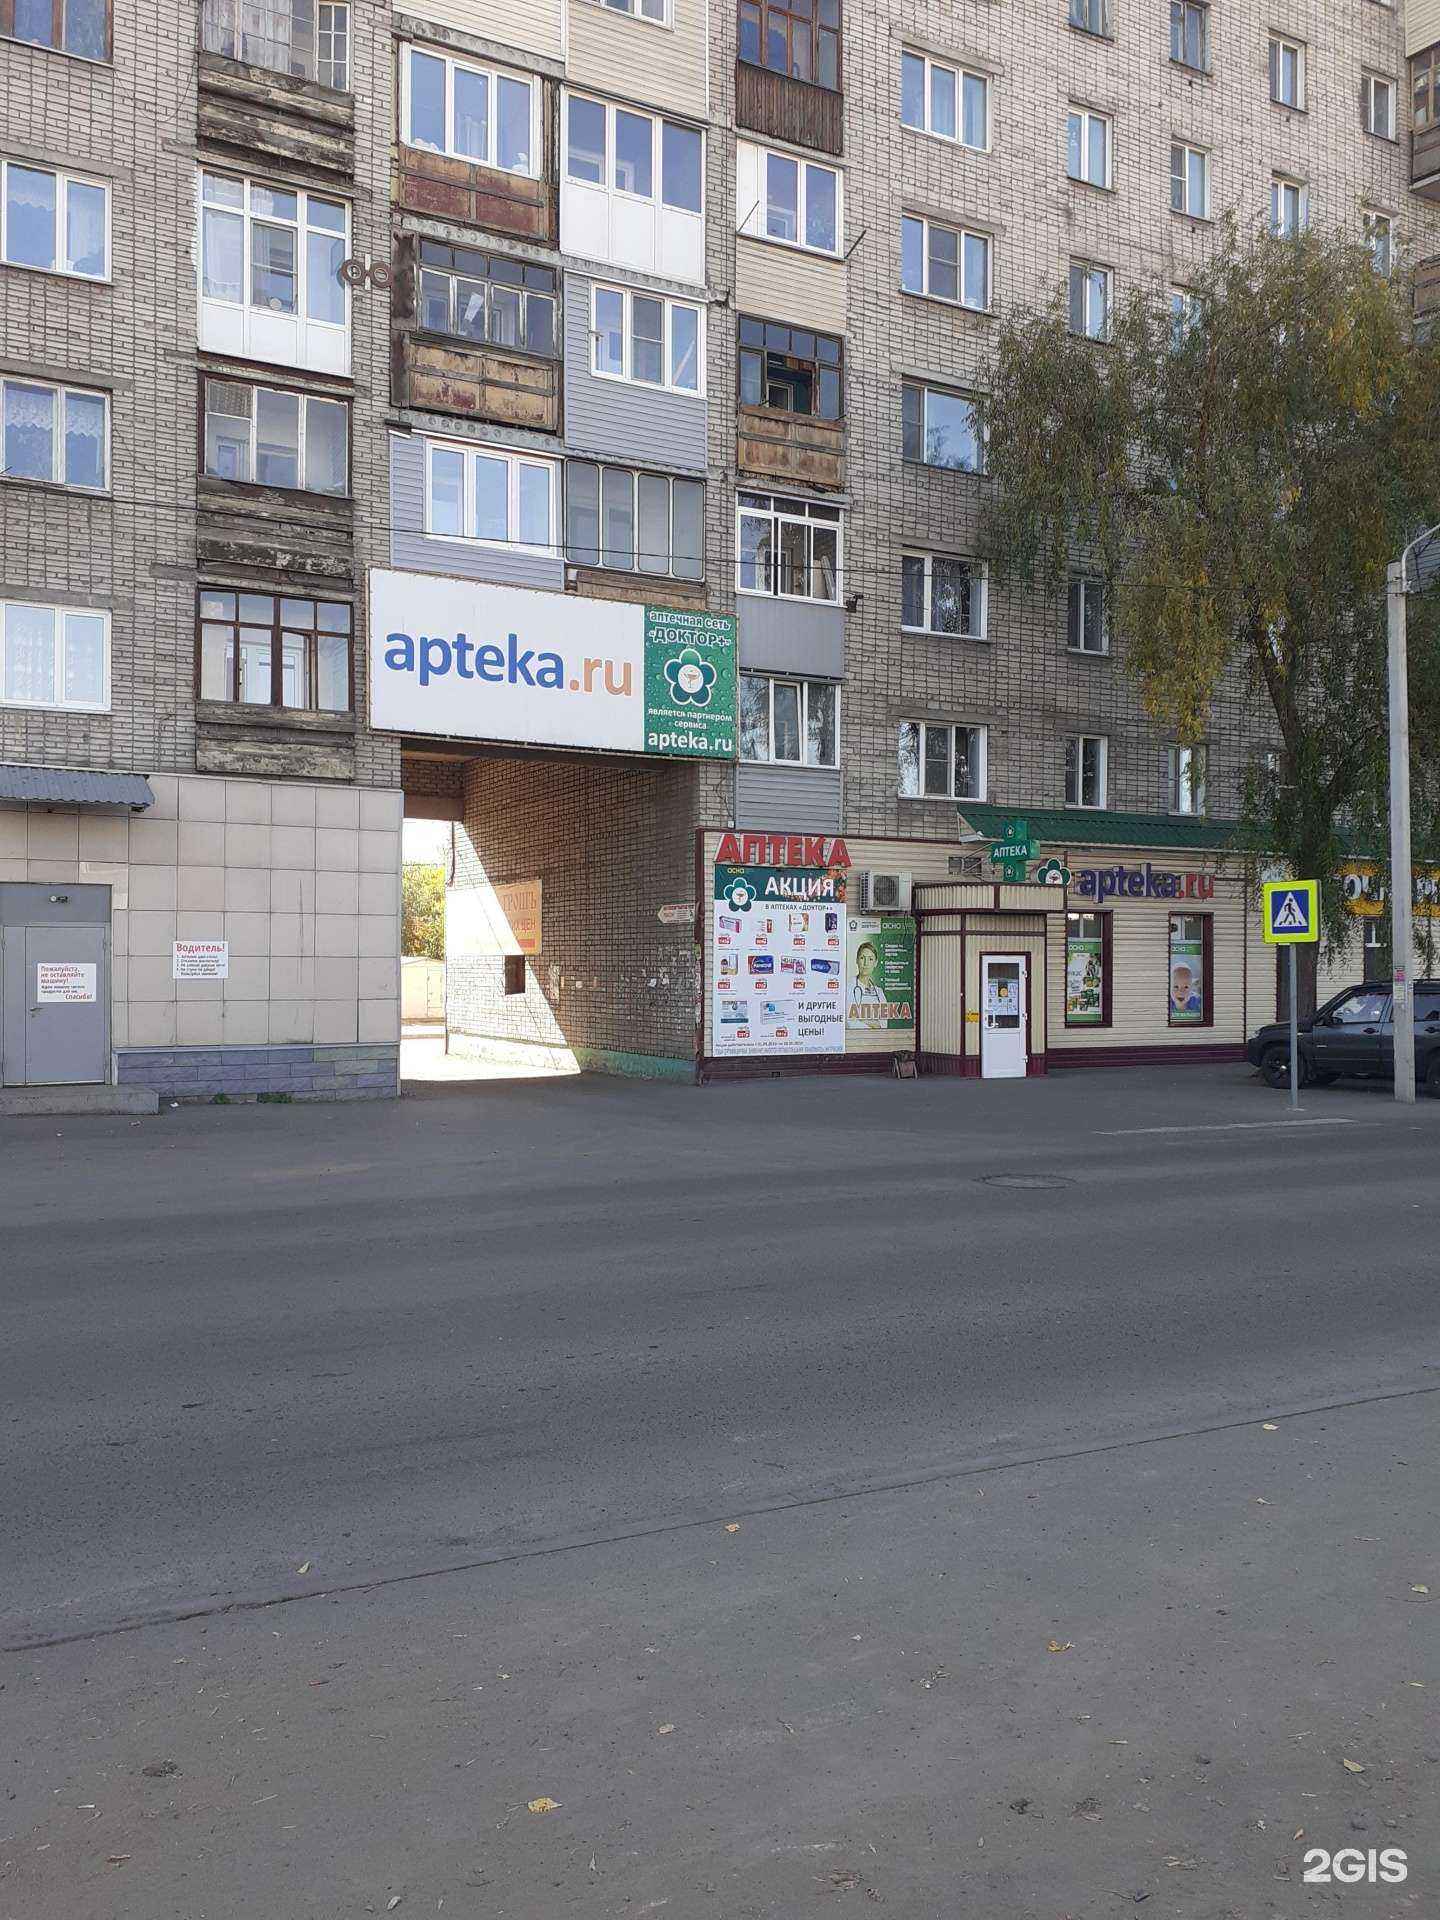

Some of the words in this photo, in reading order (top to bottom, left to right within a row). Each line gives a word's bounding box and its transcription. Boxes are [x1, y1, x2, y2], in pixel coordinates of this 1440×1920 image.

[649, 611, 703, 627] аптечная
[705, 618, 731, 630] сеть
[384, 633, 632, 696] apteka.ru
[648, 708, 686, 718] является
[687, 711, 733, 722] партнером
[674, 720, 707, 730] сервиса
[648, 731, 732, 752] apteka.ru
[714, 833, 852, 868] АПТЕКА
[993, 845, 1028, 858] АПТЕКА
[764, 876, 835, 900] АКЦИЯ
[1079, 862, 1216, 904] apteka.ru
[176, 942, 225, 954] Водитель!
[798, 1001, 804, 1010] И
[806, 1001, 837, 1010] ДРУГИЕ
[847, 1001, 912, 1021] АПТЕКА
[798, 1014, 844, 1023] ВЫГОДНЫЕ
[798, 1028, 825, 1038] ЦЕНЫ!
